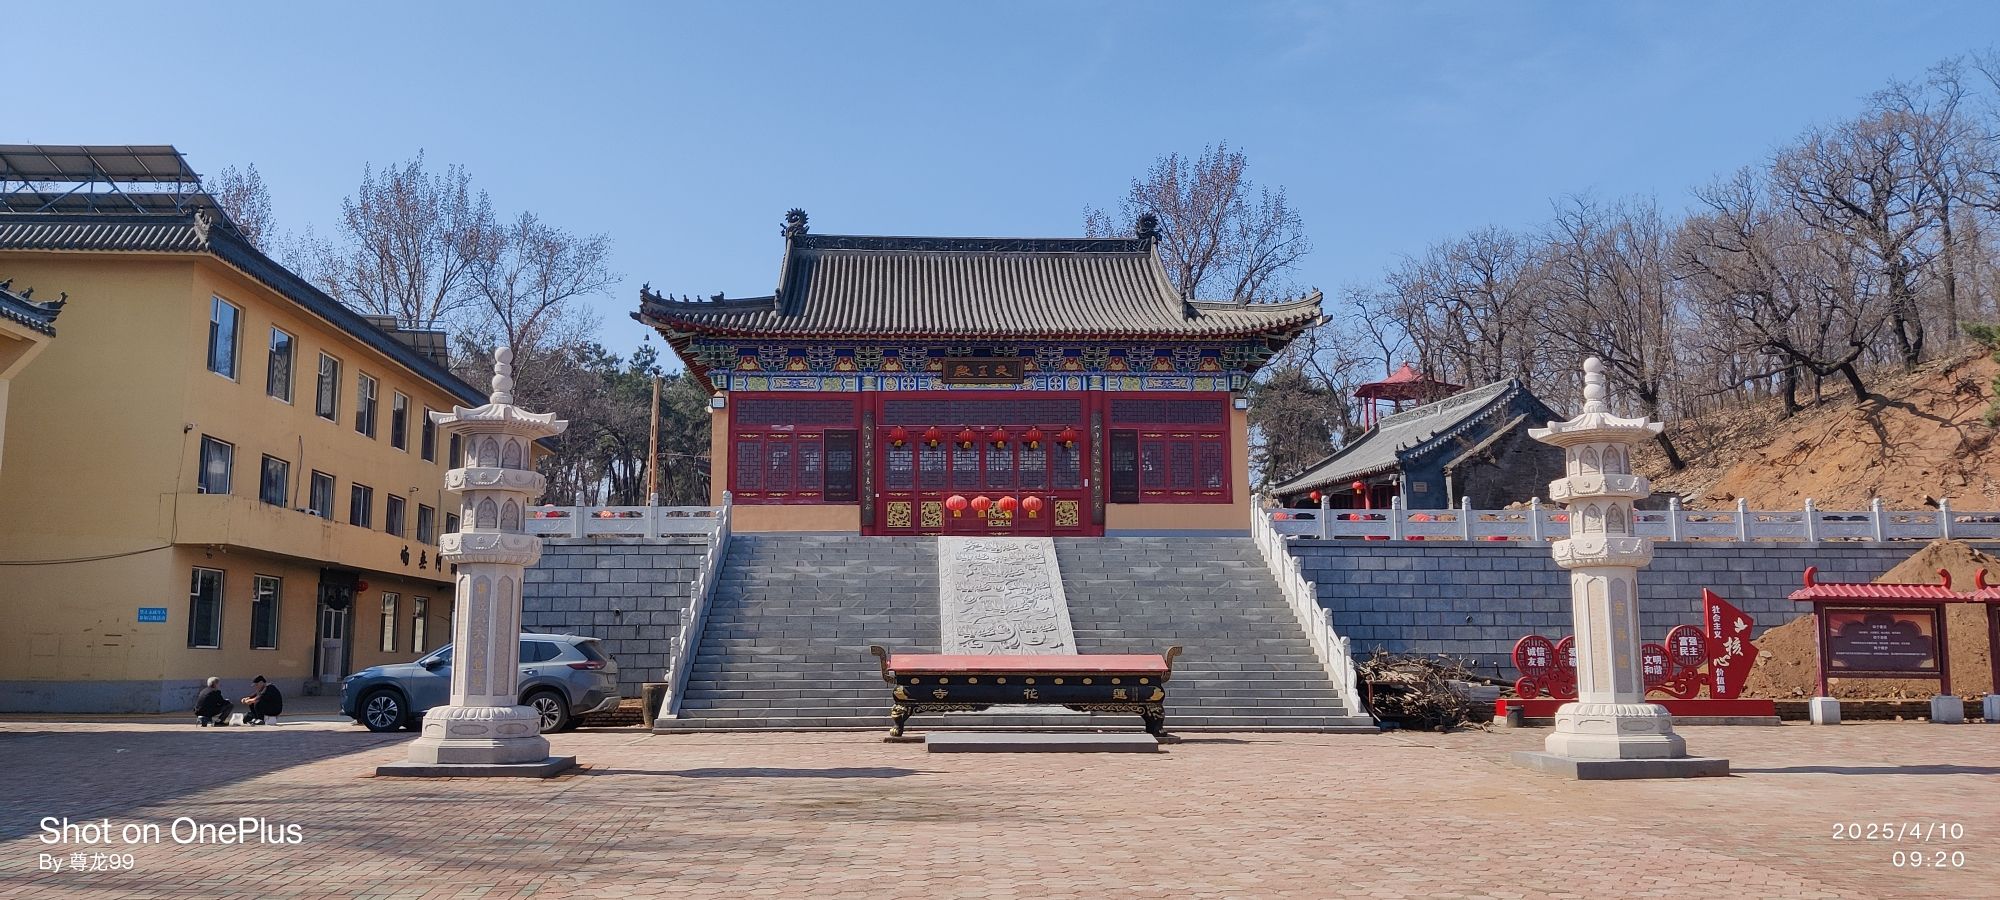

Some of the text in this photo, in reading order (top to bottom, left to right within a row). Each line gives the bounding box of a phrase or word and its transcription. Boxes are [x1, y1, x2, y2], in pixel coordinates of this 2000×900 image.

[1711, 605, 1722, 639] 社会主义
[1678, 636, 1698, 646] 富强
[1527, 646, 1545, 657] 诚信
[1679, 646, 1699, 656] 民主
[1713, 636, 1744, 668] 核心
[1527, 657, 1546, 667] 友善
[1643, 655, 1662, 665] 文明
[1644, 665, 1662, 675] 和谐
[1715, 668, 1726, 694] 价值观
